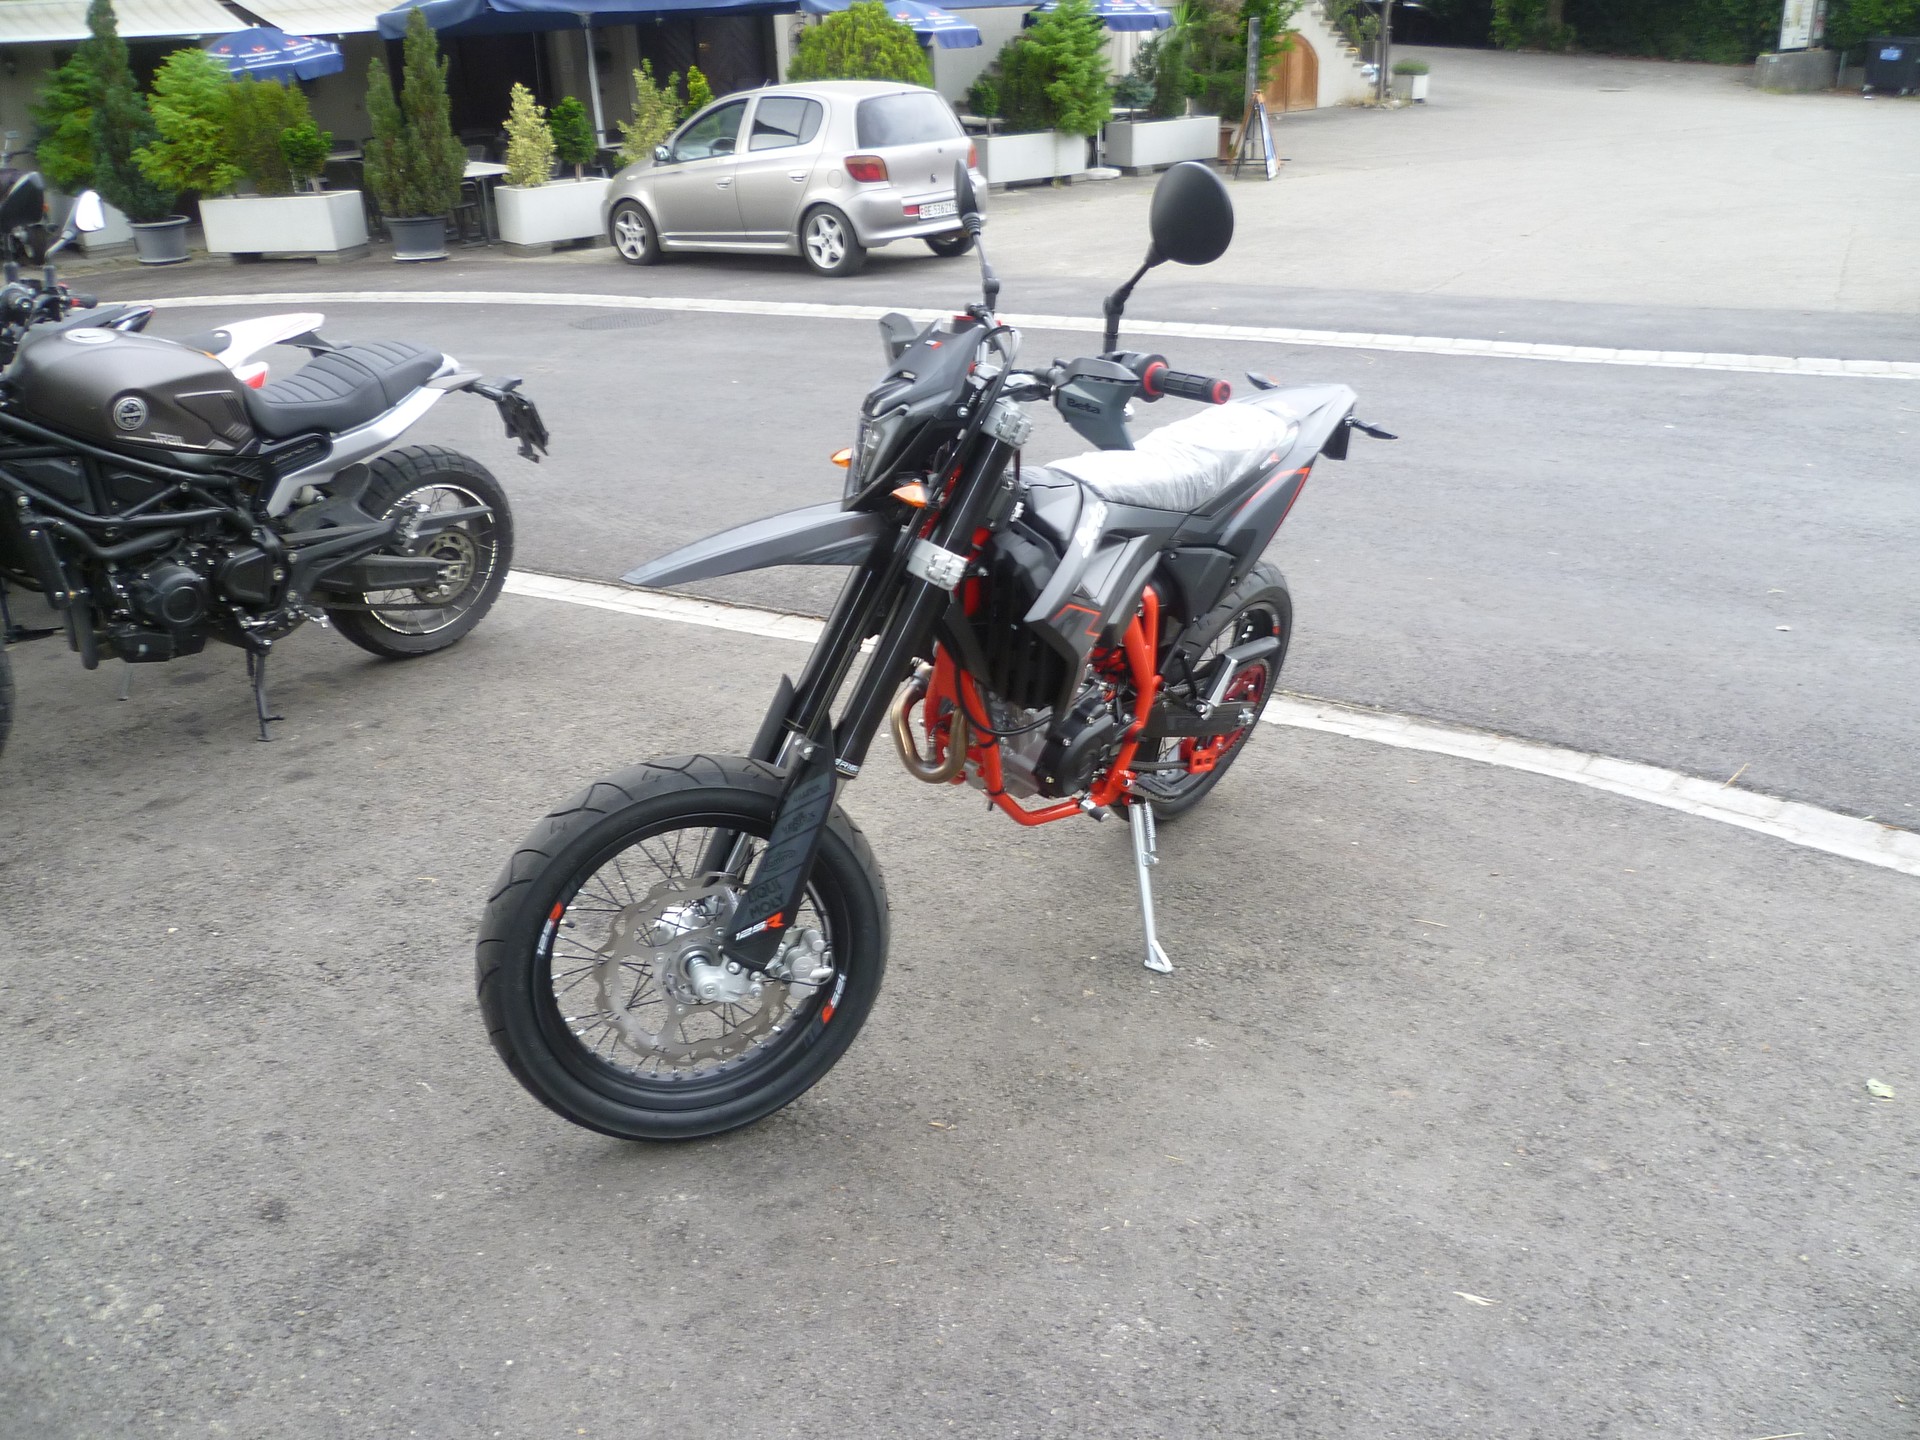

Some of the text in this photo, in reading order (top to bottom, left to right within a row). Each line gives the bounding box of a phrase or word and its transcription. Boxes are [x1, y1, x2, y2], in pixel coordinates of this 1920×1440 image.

[1066, 397, 1101, 414] Beta
[748, 879, 782, 902] LIQUI
[749, 894, 784, 919] MOLY
[735, 911, 785, 941] 125R
